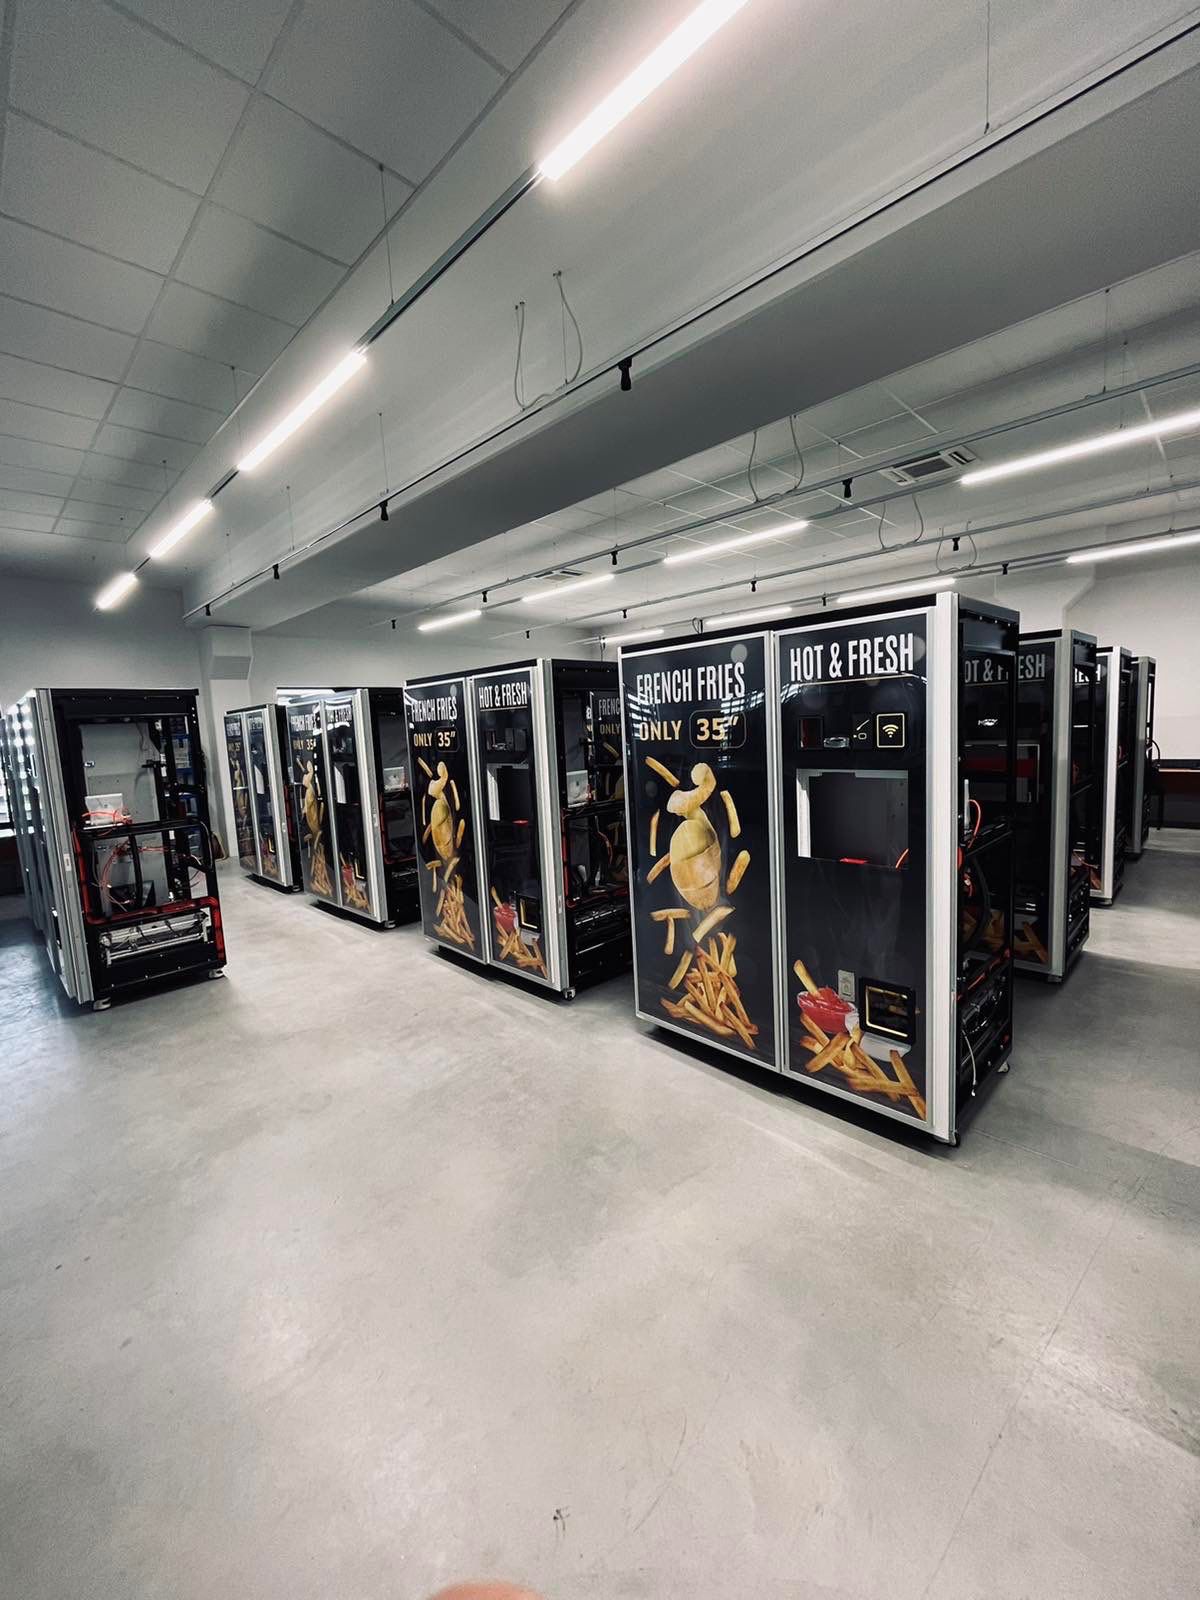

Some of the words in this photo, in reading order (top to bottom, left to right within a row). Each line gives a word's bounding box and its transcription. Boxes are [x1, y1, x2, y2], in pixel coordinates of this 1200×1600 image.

[790, 645, 824, 681] HOT
[828, 642, 843, 678] &
[847, 632, 914, 676] FRESH
[636, 668, 692, 705] FRENCH
[697, 661, 746, 701] FRIES
[965, 659, 980, 683] OT
[478, 684, 496, 709] HOT
[494, 684, 501, 707] &
[501, 681, 528, 707] FRESH
[598, 697, 621, 716] FRENC
[411, 698, 437, 722] FRENCH
[437, 696, 458, 721] FRIES
[413, 733, 433, 747] ONLY
[640, 720, 682, 741] ONLY
